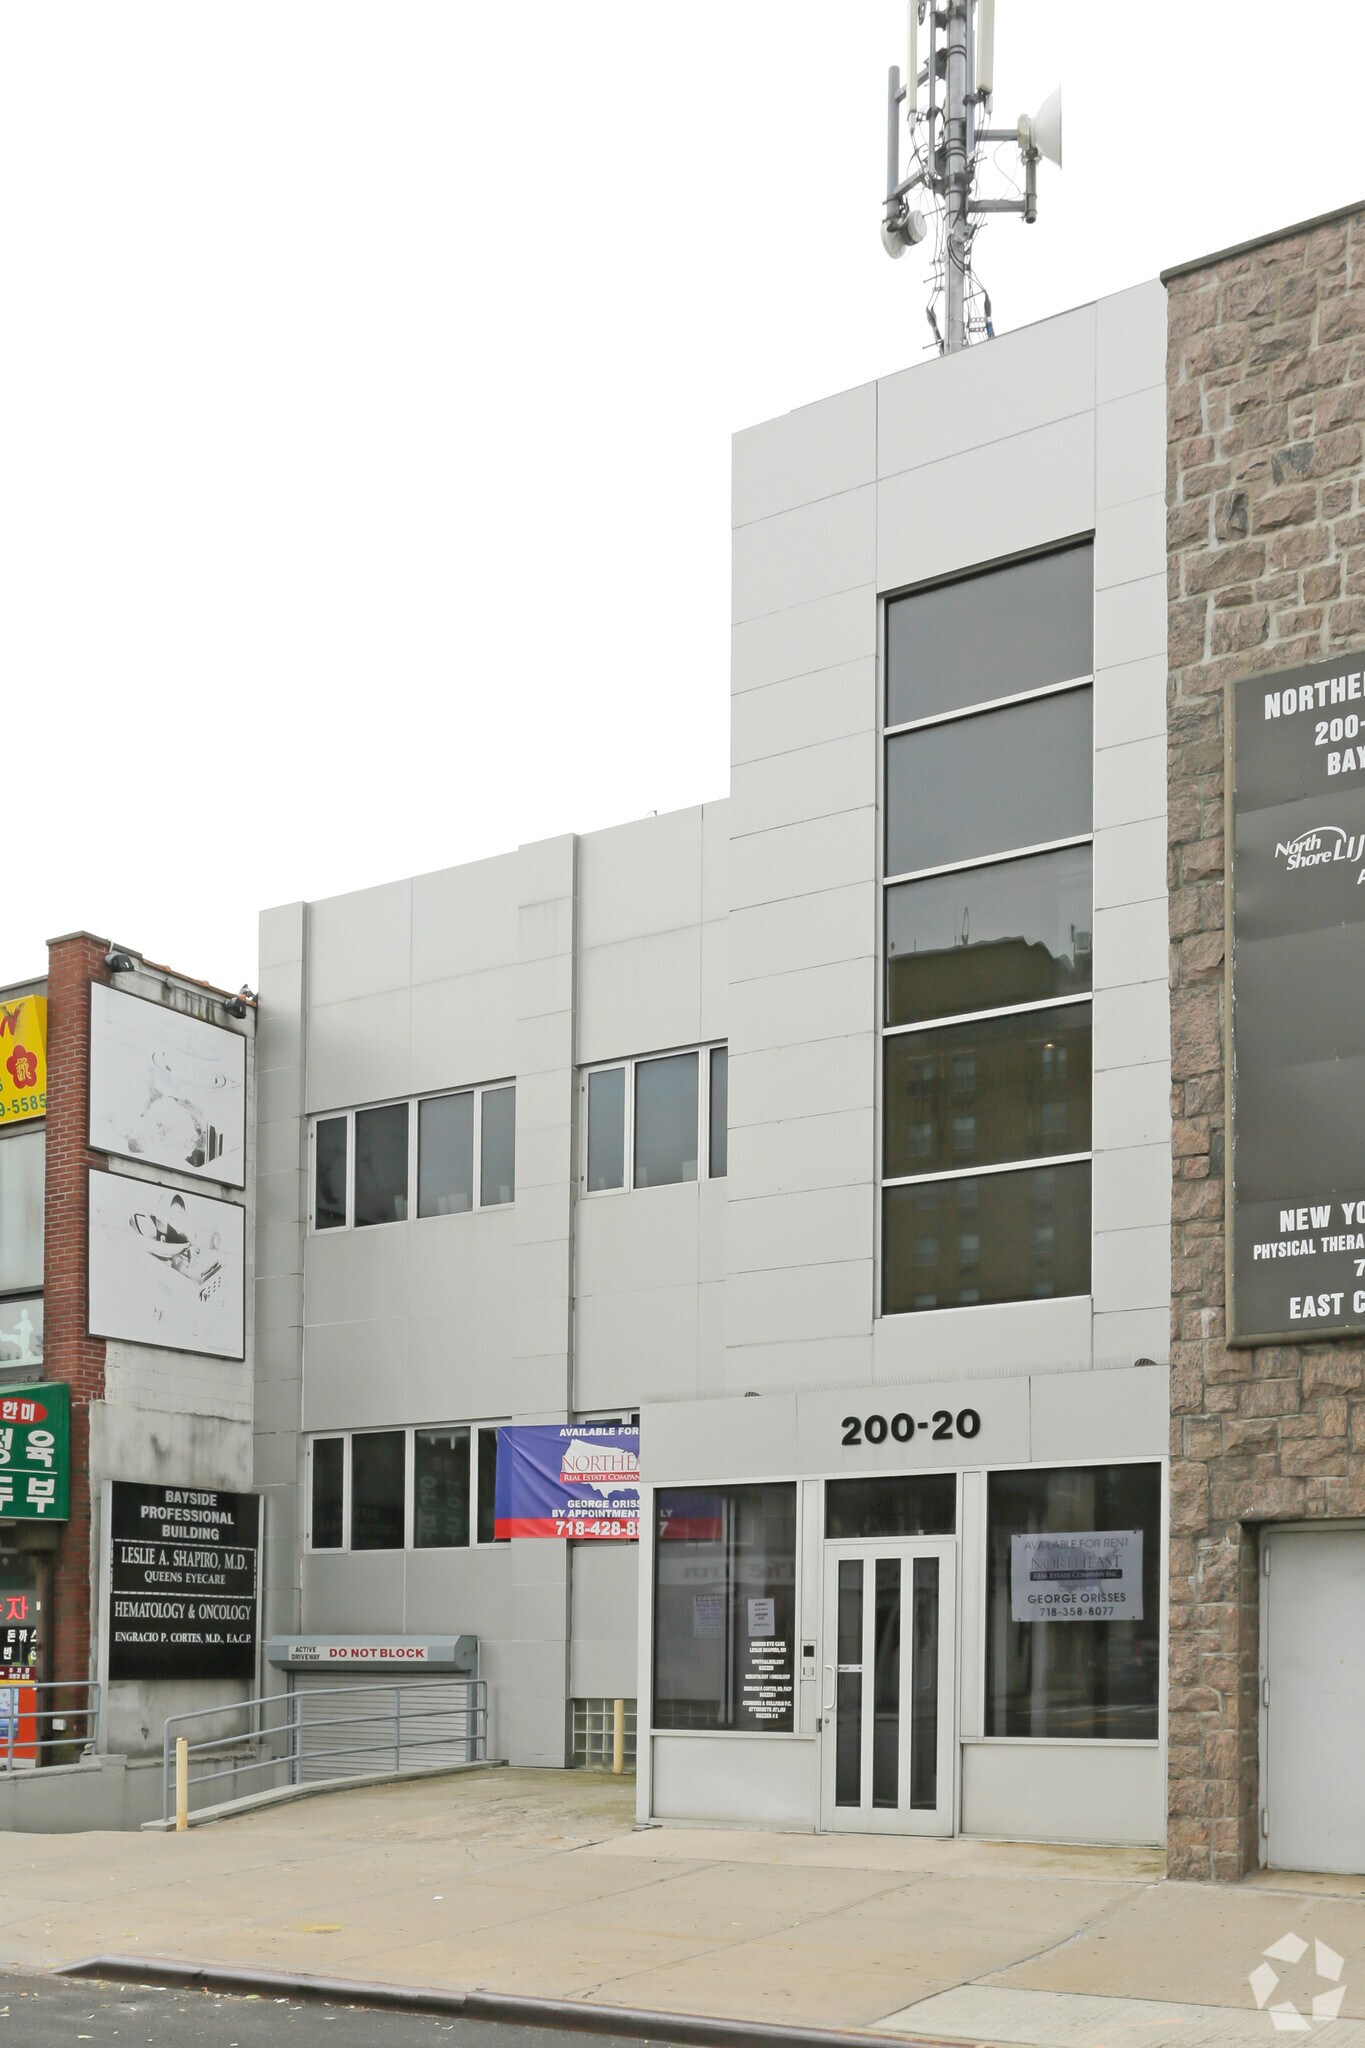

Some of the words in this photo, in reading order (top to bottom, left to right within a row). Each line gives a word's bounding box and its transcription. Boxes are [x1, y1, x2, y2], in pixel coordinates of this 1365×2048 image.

[1264, 670, 1365, 721] NORTHE
[1327, 745, 1365, 776] BAY
[1275, 833, 1322, 858] North
[1286, 850, 1332, 870] Shore
[1279, 1205, 1331, 1233] NEW
[1253, 1238, 1317, 1260] PHYSICAL
[1321, 1233, 1365, 1253] THERA
[1289, 1292, 1345, 1319] EAST
[2, 1401, 35, 1421] 한미
[559, 1427, 615, 1437] AVAILABLE
[618, 1427, 639, 1436] FOR
[841, 1408, 981, 1446] 200-20
[582, 1473, 607, 1481] ESTATE
[165, 1490, 217, 1506] BAYSIDE
[567, 1500, 609, 1508] GEORGE
[140, 1505, 235, 1525] PROFESSIONAL
[552, 1509, 566, 1518] BY
[161, 1524, 219, 1541] BUILDING
[1024, 1539, 1077, 1551] AVAILABLE
[1080, 1539, 1101, 1548] FOR
[1104, 1537, 1129, 1548] RENT
[121, 1546, 155, 1565] LESLIE
[158, 1550, 170, 1566] A.
[173, 1550, 221, 1570] SHAPIRO,
[224, 1553, 248, 1570] M.D.
[1030, 1555, 1123, 1570] NORTHEAST
[144, 1570, 182, 1583] QUEENS
[185, 1572, 226, 1585] EYECARE
[1027, 1593, 1077, 1604] GEORGE
[1080, 1592, 1126, 1603] ORISSES
[114, 1601, 185, 1619] HEMATOLOGY
[188, 1604, 195, 1619] &
[198, 1603, 251, 1620] ONCOLOGY
[1040, 1606, 1114, 1617] 718-358-8077
[114, 1632, 159, 1643] ENGRACIO
[160, 1632, 168, 1643] P.
[170, 1633, 203, 1644] CORTES,
[329, 1648, 348, 1658] DO
[351, 1648, 377, 1658] NOT
[380, 1648, 424, 1658] BLOCK
